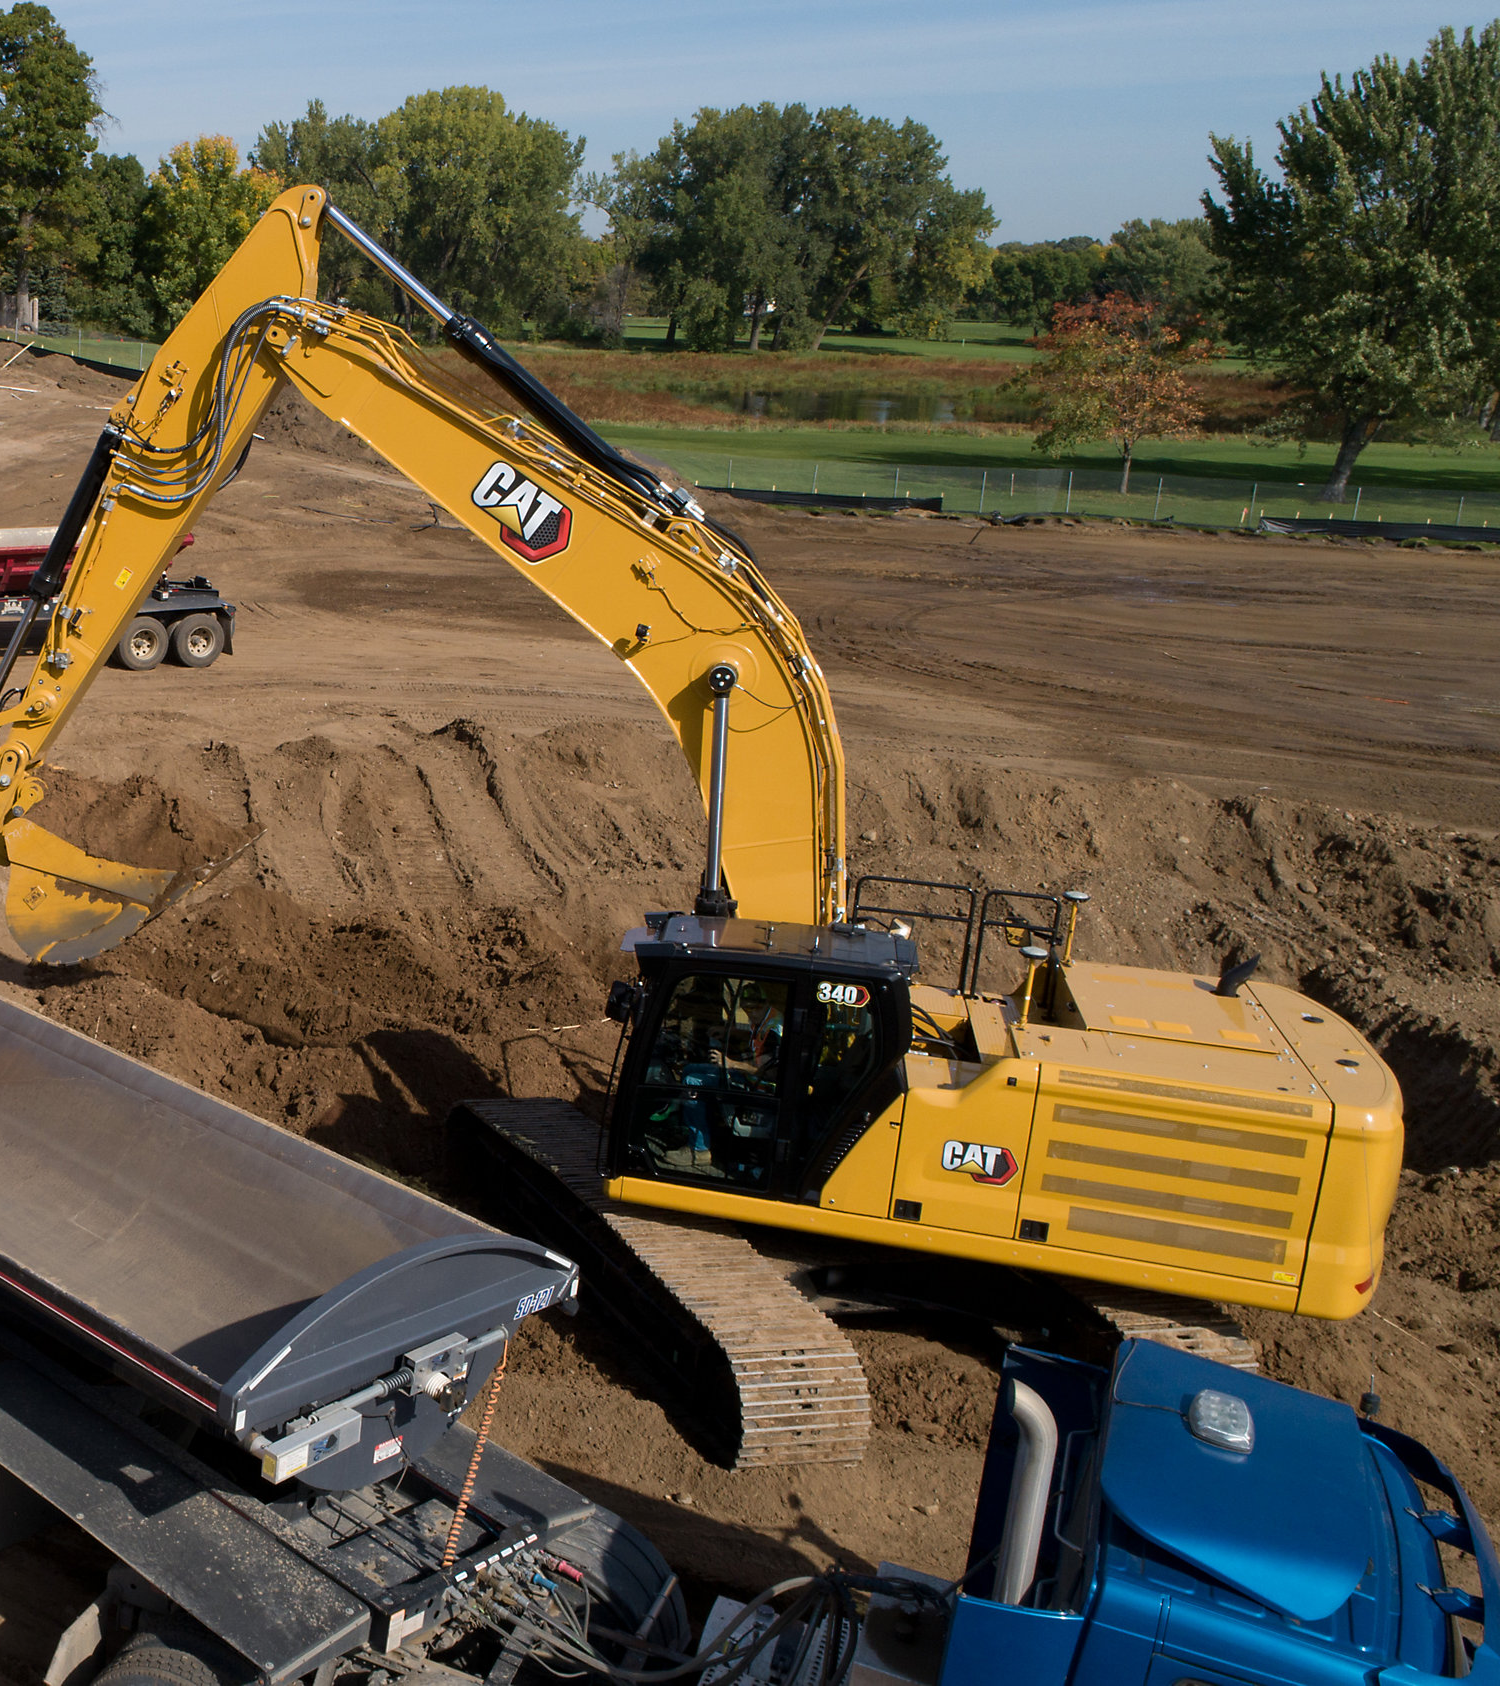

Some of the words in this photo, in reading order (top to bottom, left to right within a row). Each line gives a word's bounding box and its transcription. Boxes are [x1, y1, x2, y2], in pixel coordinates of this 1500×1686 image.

[472, 461, 563, 541] CAT
[818, 982, 858, 1004] 340
[942, 1140, 1002, 1176] CAT
[513, 1285, 556, 1321] SD-121
